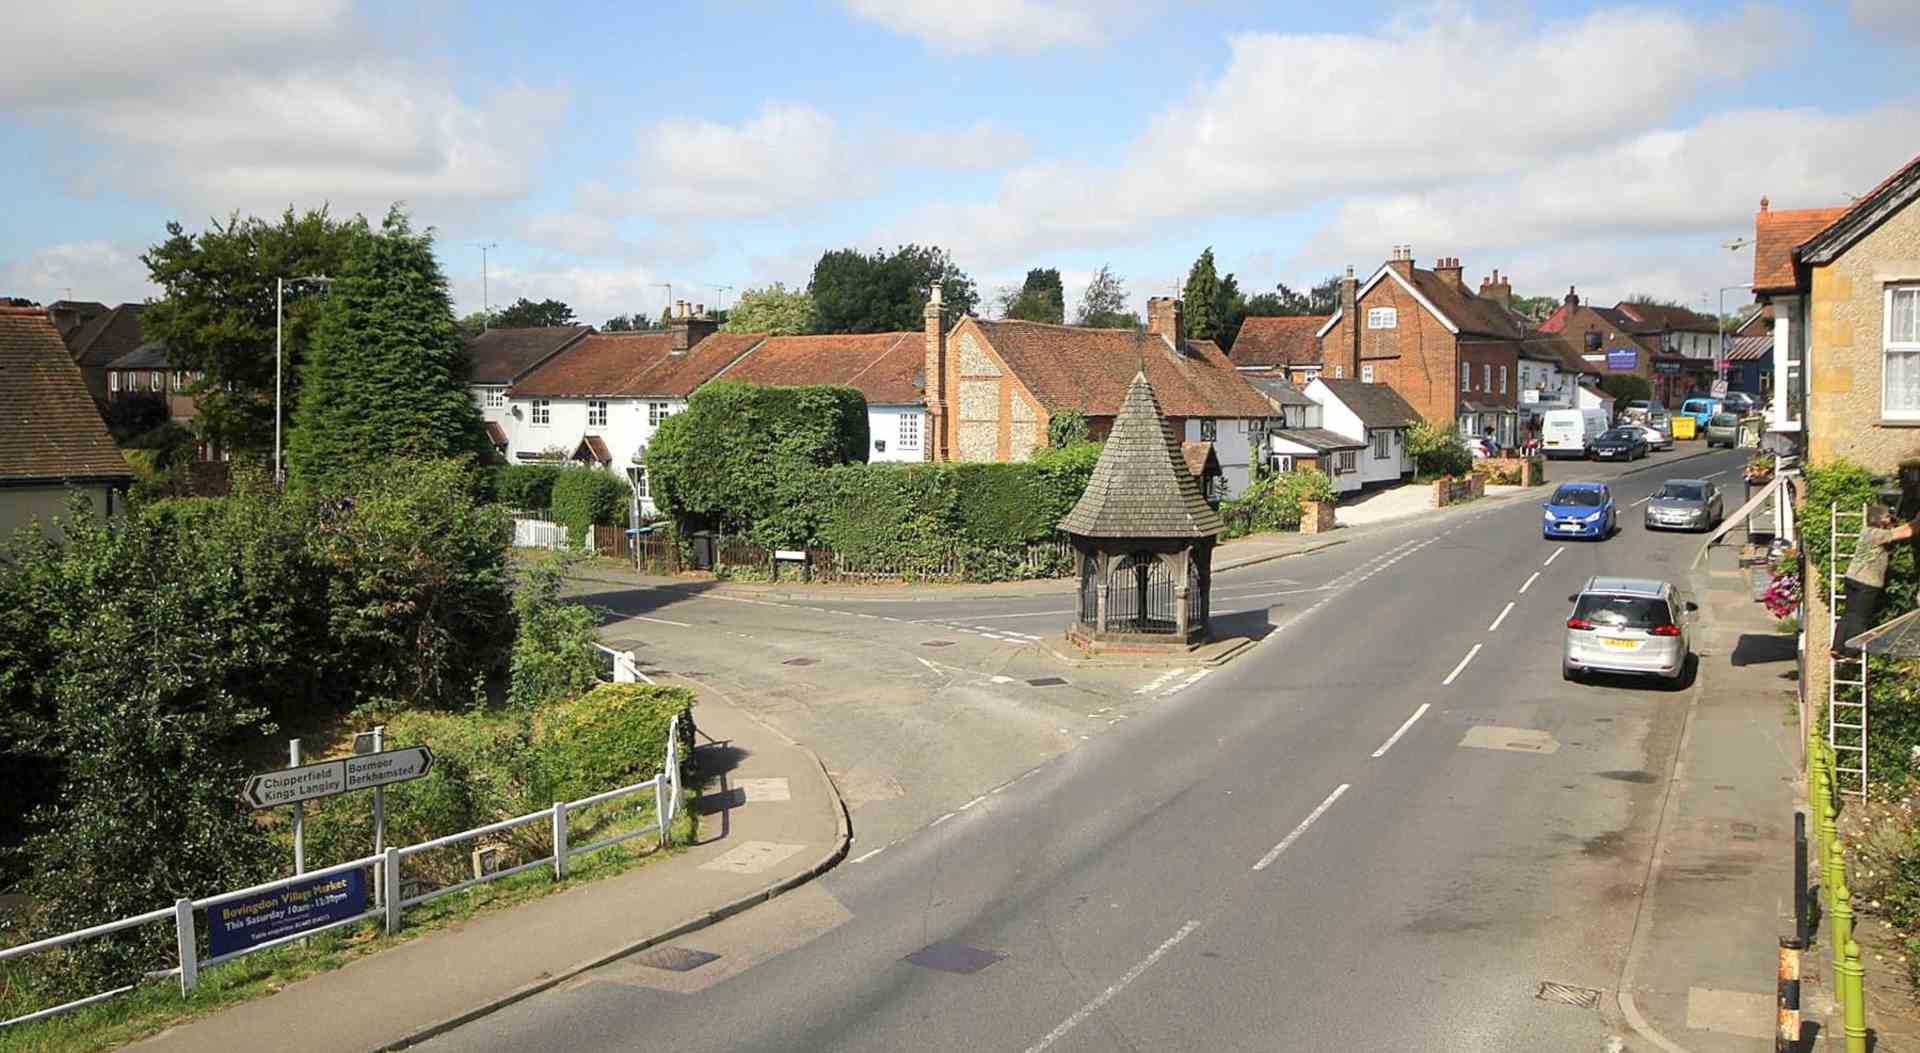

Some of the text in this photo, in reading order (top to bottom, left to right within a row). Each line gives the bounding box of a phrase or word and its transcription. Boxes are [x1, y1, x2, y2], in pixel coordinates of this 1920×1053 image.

[348, 759, 393, 774] Boxmoor
[349, 764, 415, 785] Berkhamsted
[263, 768, 332, 789] Chipperfield
[264, 780, 341, 801] Kings Langley
[222, 898, 279, 920] Bovingdon
[313, 879, 348, 896] Market
[224, 920, 244, 932] This
[245, 909, 286, 926] Saturday
[287, 904, 310, 915] 10am
